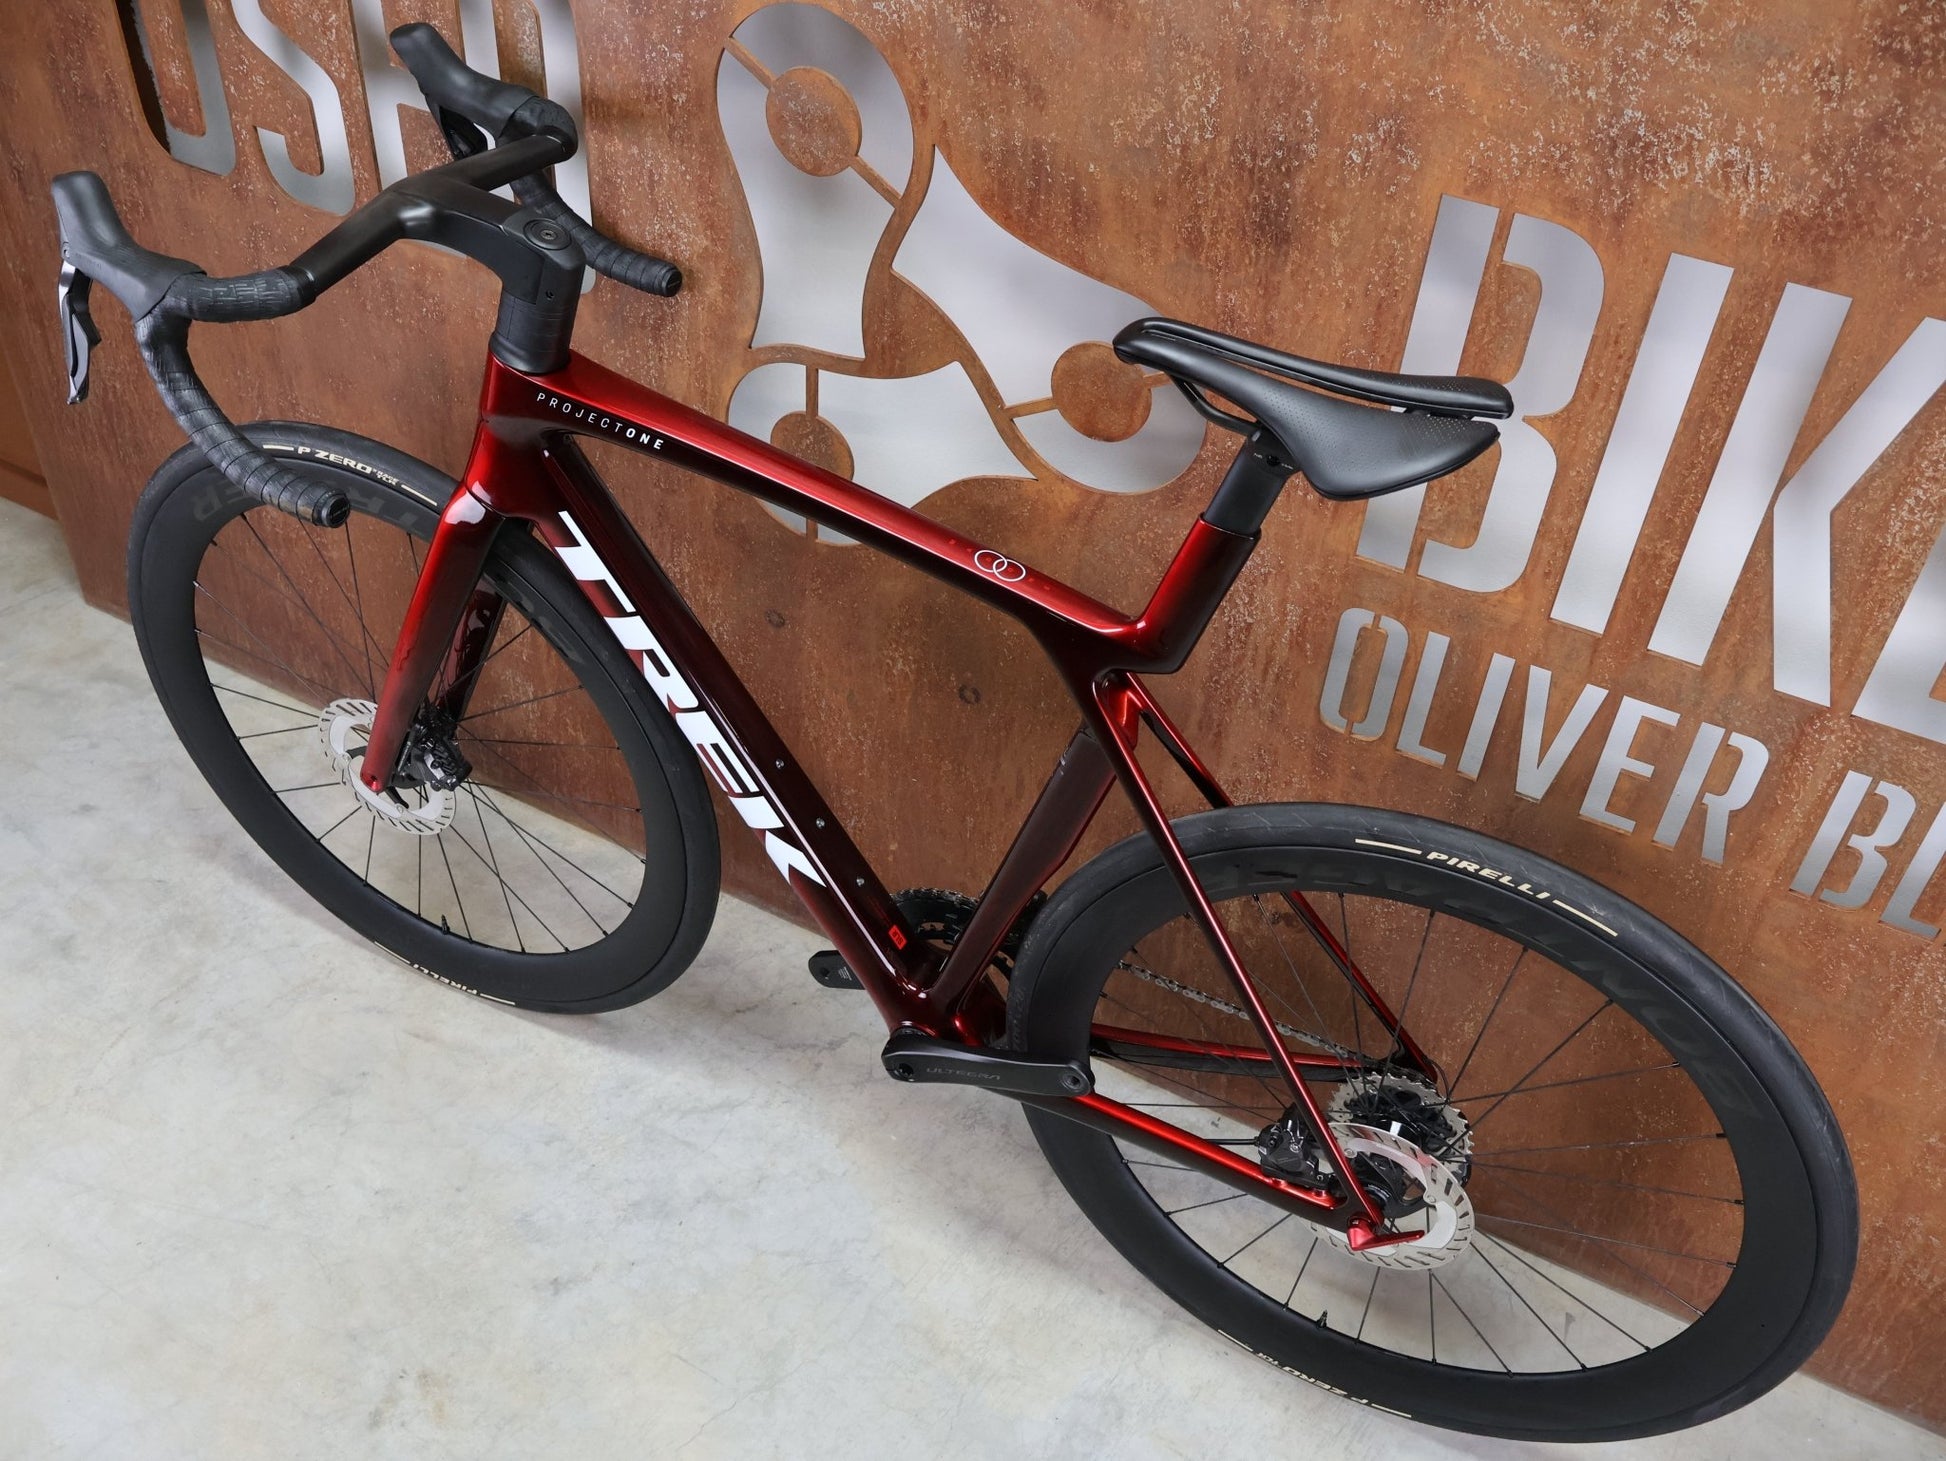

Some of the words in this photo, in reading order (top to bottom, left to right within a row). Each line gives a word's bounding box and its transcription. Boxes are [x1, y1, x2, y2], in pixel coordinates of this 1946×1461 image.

[298, 446, 312, 454] P
[314, 449, 373, 474] ZERO
[554, 510, 828, 888] TREK
[1319, 607, 1769, 865] OLIVER
[1426, 851, 1551, 900] PIRELLI
[413, 963, 478, 995] PIRELLI
